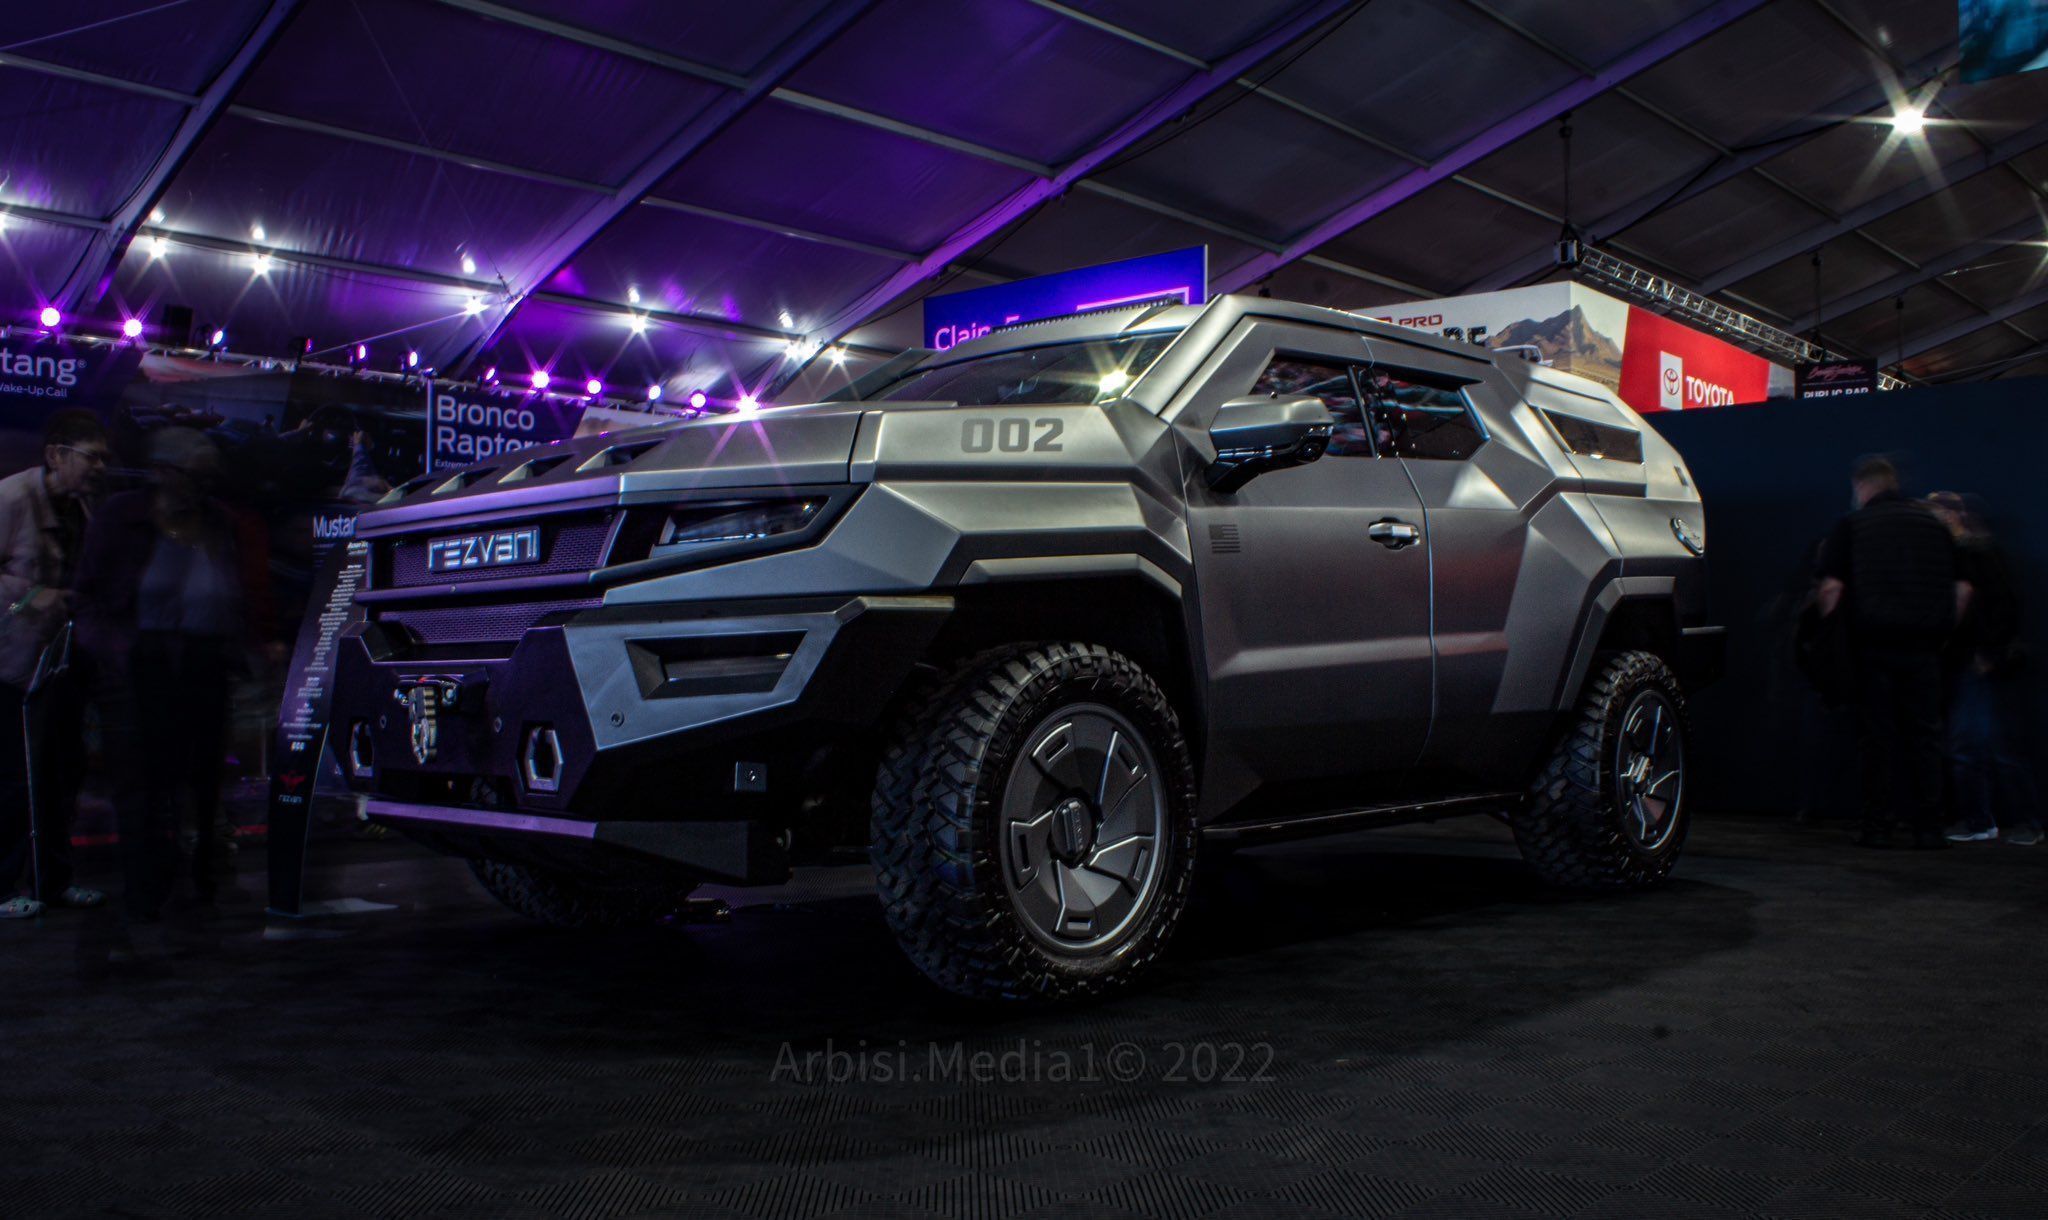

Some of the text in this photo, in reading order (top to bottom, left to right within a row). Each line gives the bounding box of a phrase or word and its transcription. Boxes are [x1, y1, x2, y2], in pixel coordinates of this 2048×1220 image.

[46, 386, 68, 398] Call
[1686, 375, 1735, 407] TOYOTA
[436, 394, 535, 431] Bronco
[961, 418, 1064, 453] 002
